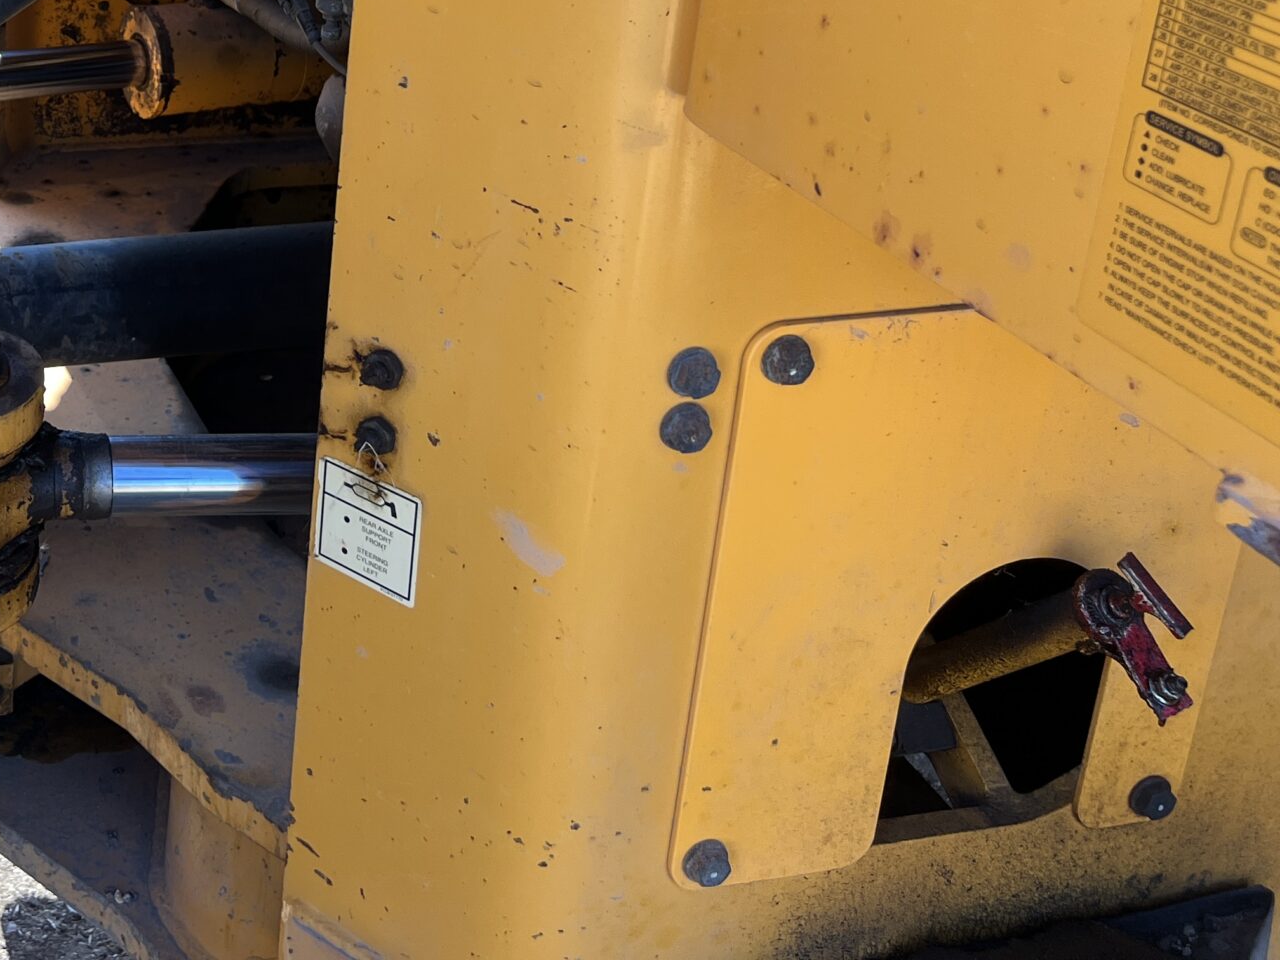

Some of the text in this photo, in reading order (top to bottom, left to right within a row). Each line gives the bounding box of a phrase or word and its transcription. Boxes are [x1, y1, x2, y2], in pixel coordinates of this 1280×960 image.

[1148, 113, 1220, 156] SERVICE SYMBOL
[1153, 134, 1180, 153] CHECK
[1150, 147, 1176, 166] CLEAN
[1165, 167, 1206, 198] LUBRICATE
[1176, 188, 1211, 217] REPLACE
[1121, 217, 1135, 232] THE
[1135, 225, 1165, 248] SERVICE
[1124, 205, 1153, 227] SERVICE
[1153, 220, 1193, 248] INTERVALS
[1191, 240, 1208, 256] ARE
[1114, 242, 1126, 256] DO
[1125, 248, 1141, 264] NOT
[1140, 257, 1162, 276] OPEN
[1161, 269, 1176, 284] THE
[1174, 276, 1192, 293] CAP
[1118, 229, 1128, 242] BE
[1128, 235, 1147, 252] SURE
[1147, 245, 1158, 258] OF
[1157, 251, 1185, 273] ENGINE
[1184, 266, 1206, 285] STOP
[1111, 255, 1132, 273] OPEN
[1131, 266, 1146, 281] THE
[1145, 274, 1161, 290] CAP
[1109, 268, 1137, 290] ALWAYS
[1136, 284, 1156, 301] KEEP
[1156, 295, 1170, 310] THE
[1114, 285, 1133, 303] CASE
[1132, 296, 1143, 309] OF
[1103, 293, 1122, 311] READ
[358, 516, 394, 538] REAR AXLE
[361, 526, 392, 545] SUPPORT
[365, 536, 387, 551] FRONT
[356, 546, 388, 566] STEERING
[356, 554, 388, 574] CYLINDER
[362, 566, 378, 578] LEFT
